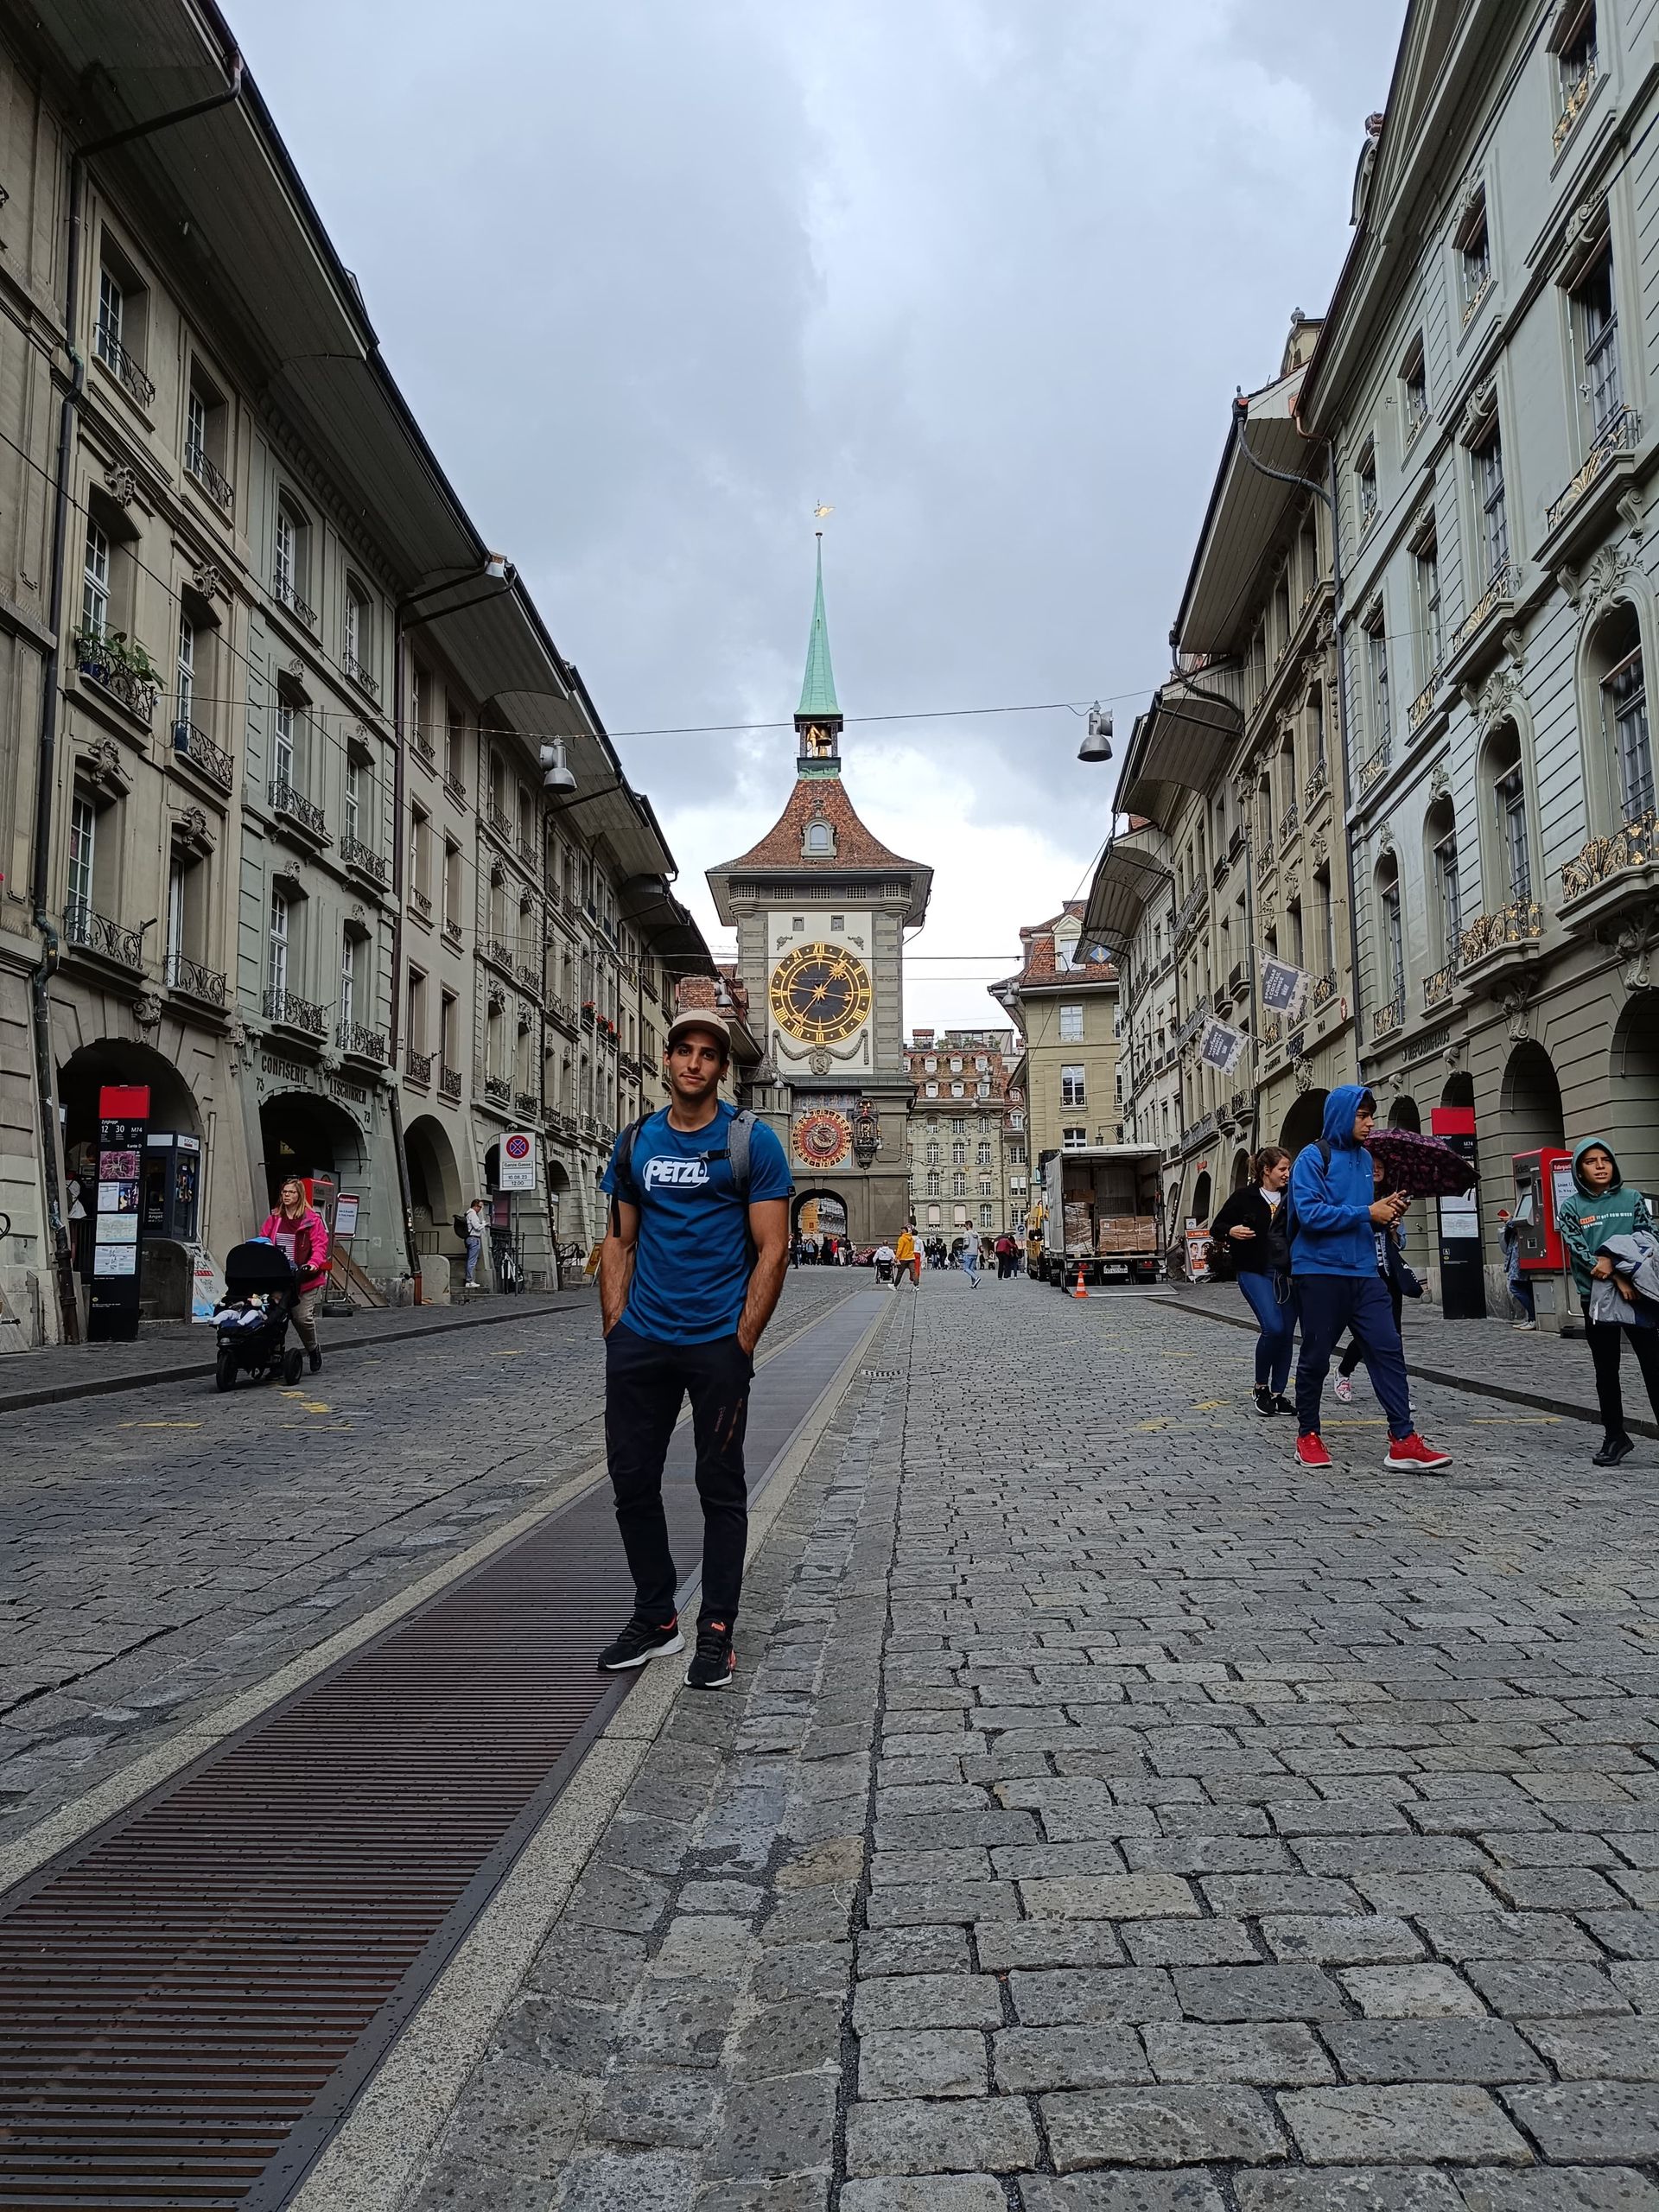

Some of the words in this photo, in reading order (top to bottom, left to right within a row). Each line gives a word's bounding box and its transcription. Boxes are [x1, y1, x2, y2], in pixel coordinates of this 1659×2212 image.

[1269, 972, 1281, 995] COCKTAIL
[1274, 976, 1284, 996] LOUNGE
[262, 1055, 308, 1085] CONFISERIE
[645, 1160, 709, 1191] PETZL
